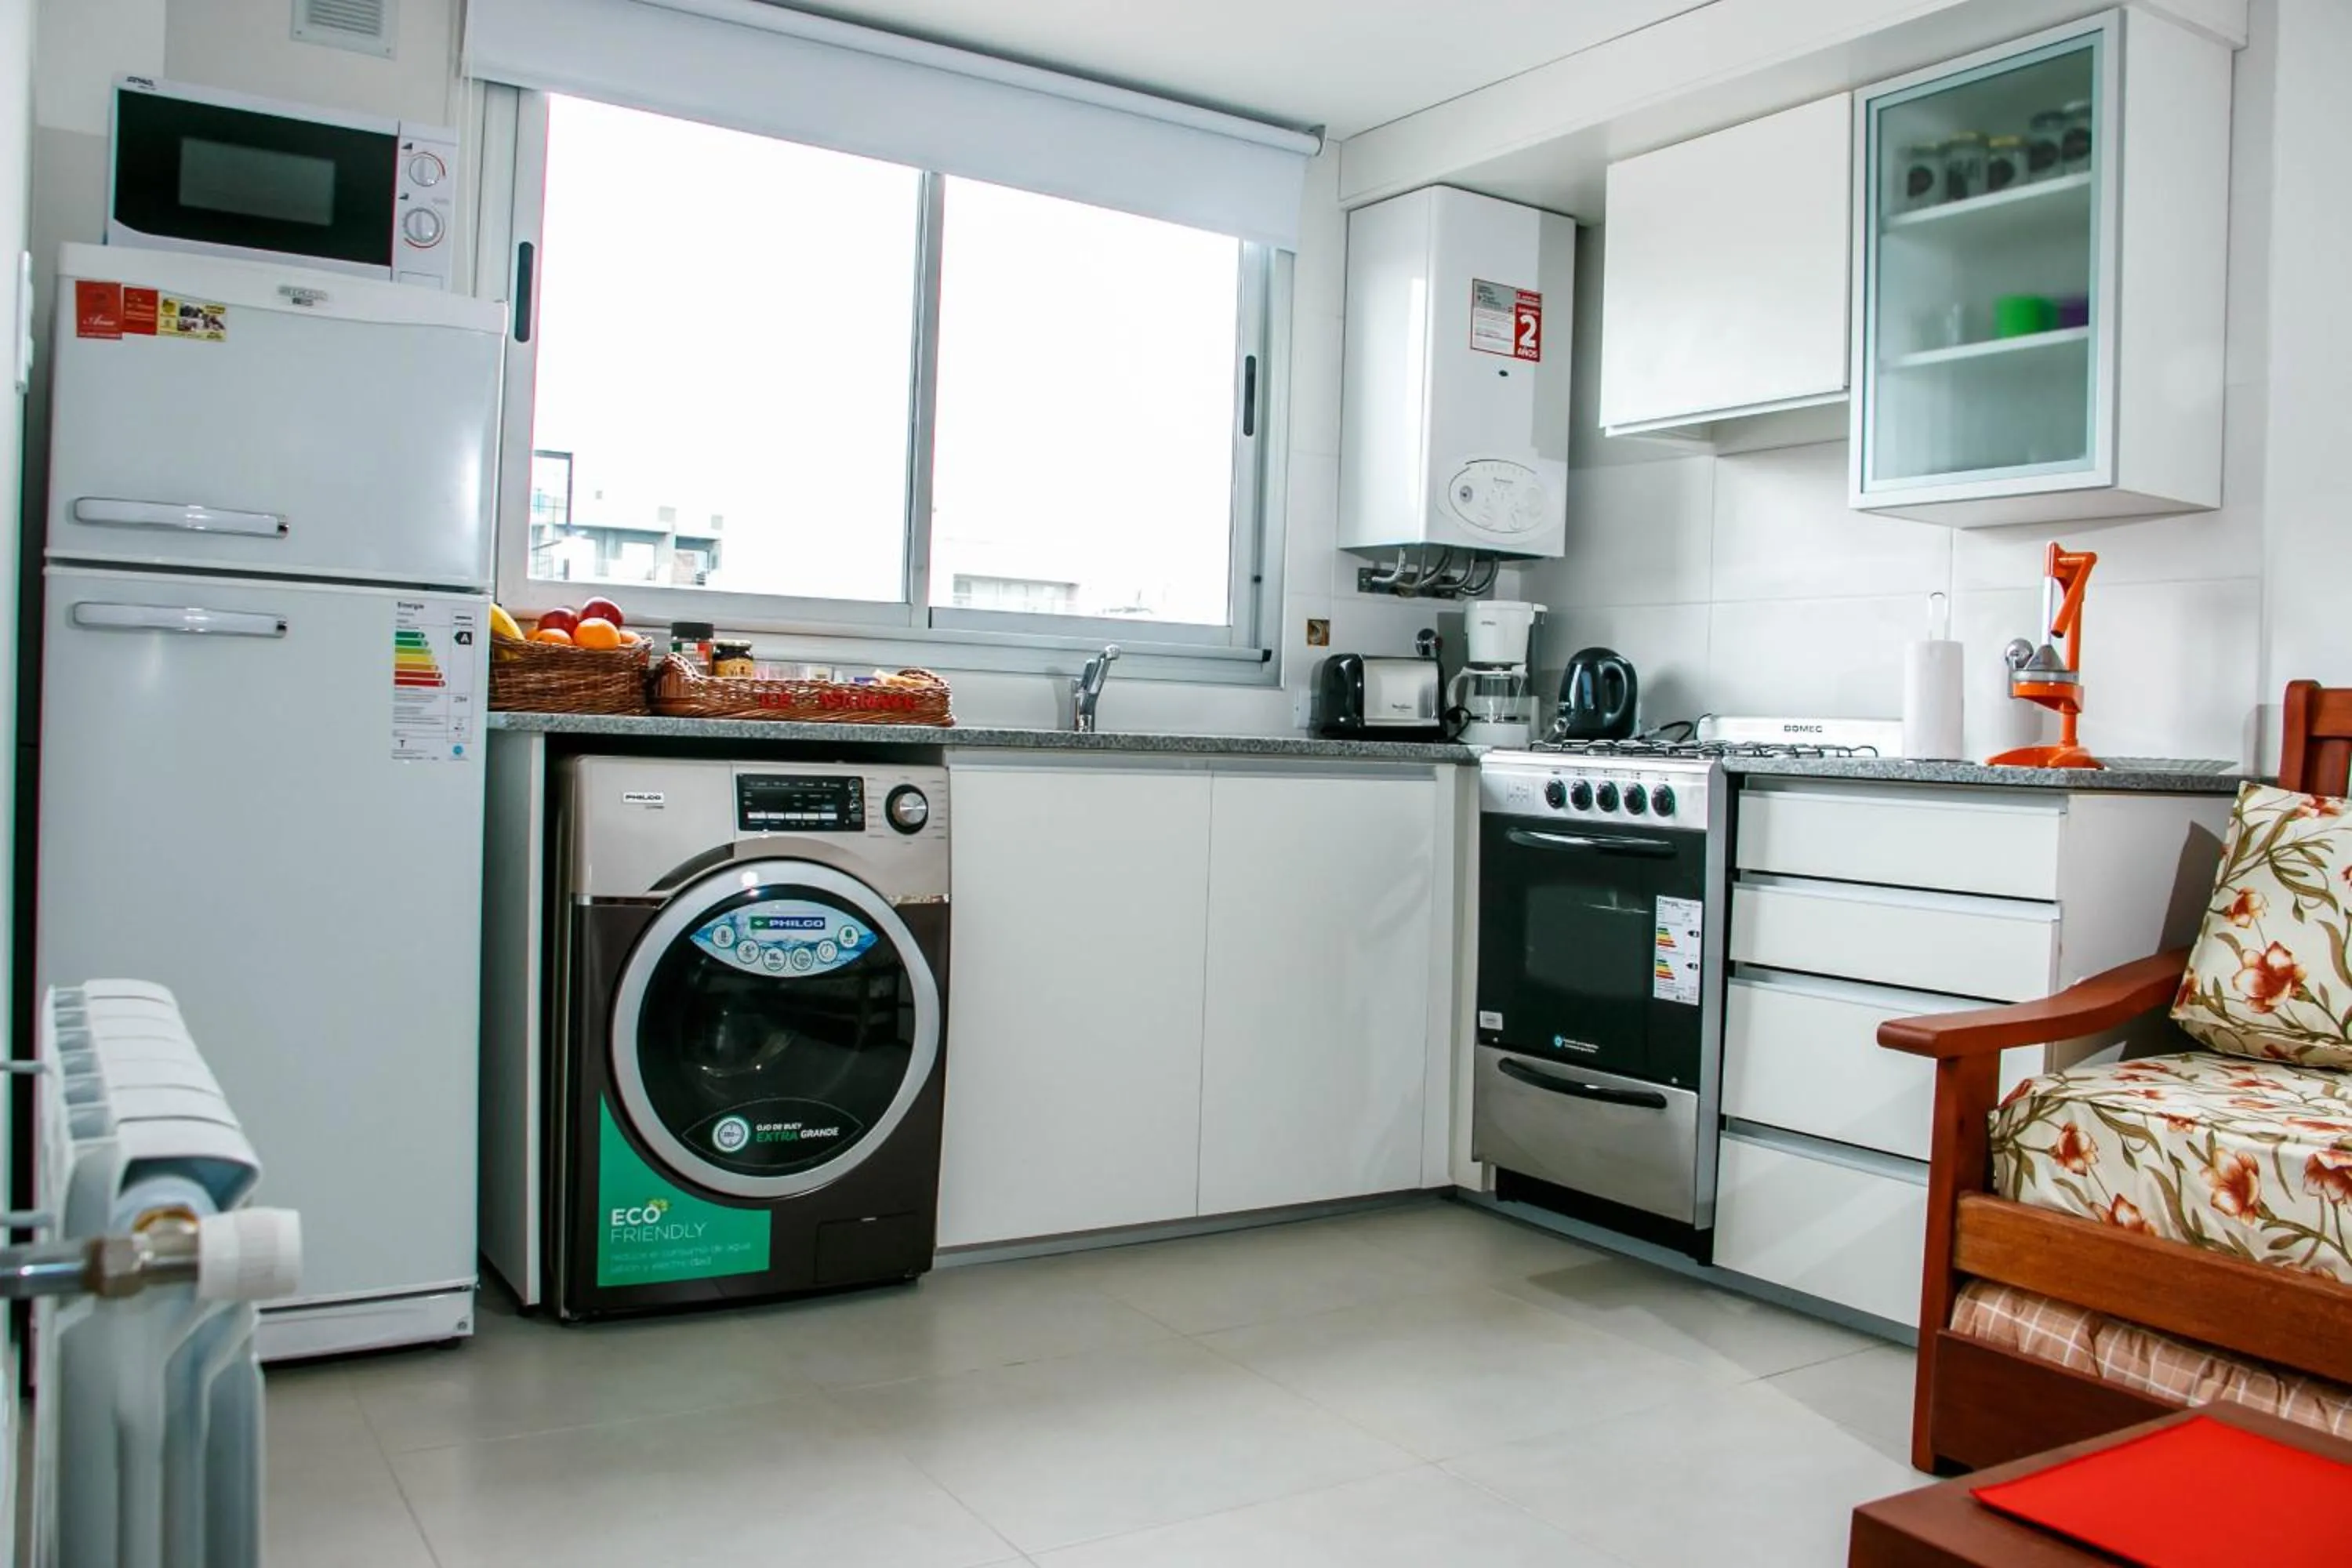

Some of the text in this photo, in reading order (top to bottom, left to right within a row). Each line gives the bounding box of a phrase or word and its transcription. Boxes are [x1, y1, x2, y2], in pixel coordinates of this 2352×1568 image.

[1519, 314, 1537, 348] 2
[461, 633, 470, 643] A
[768, 919, 824, 928] PHILCO
[757, 1127, 840, 1142] EXTRA GRANDE
[611, 1206, 661, 1226] ECO
[611, 1221, 707, 1243] FRIENDLY
